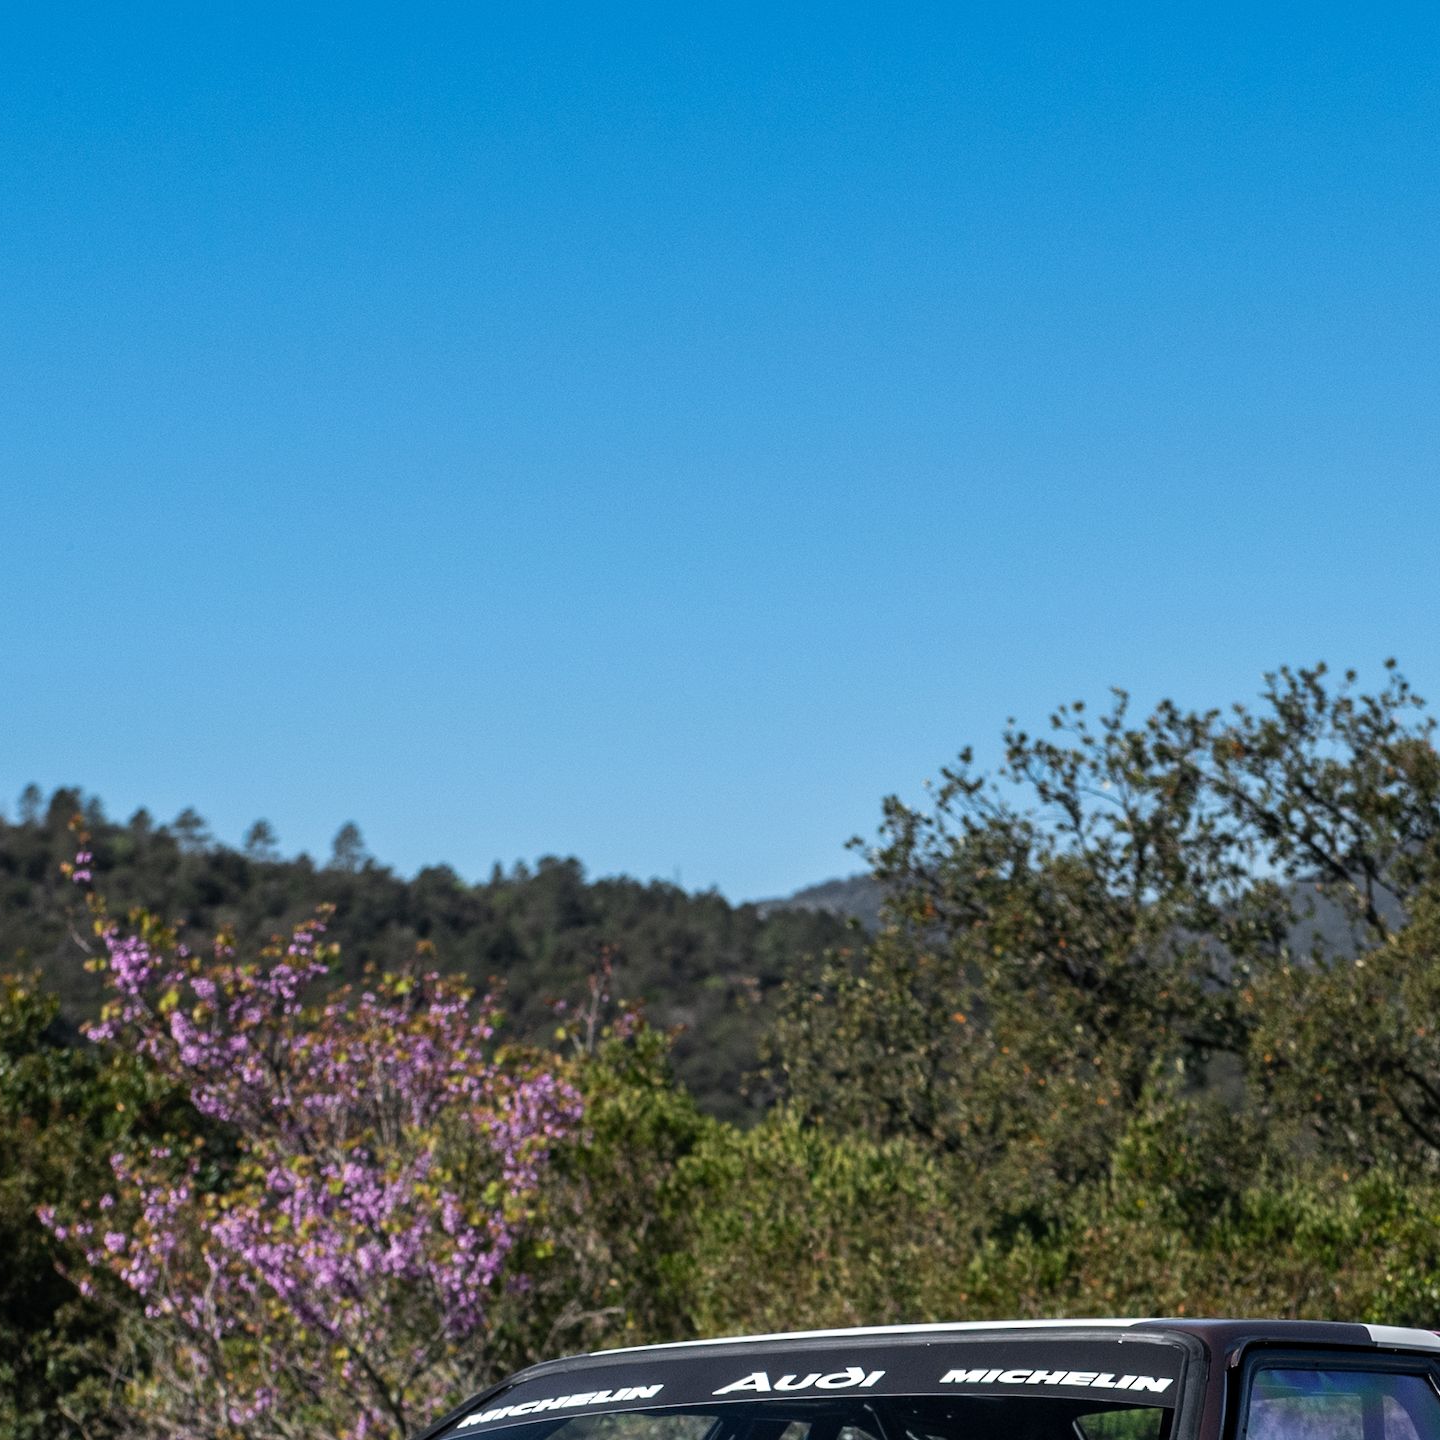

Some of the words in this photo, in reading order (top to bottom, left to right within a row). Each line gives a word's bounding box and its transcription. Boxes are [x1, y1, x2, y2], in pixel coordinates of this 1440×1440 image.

[457, 1384, 664, 1428] MICHELIN
[712, 1366, 886, 1396] Audi
[939, 1369, 1174, 1394] MICHELIN
